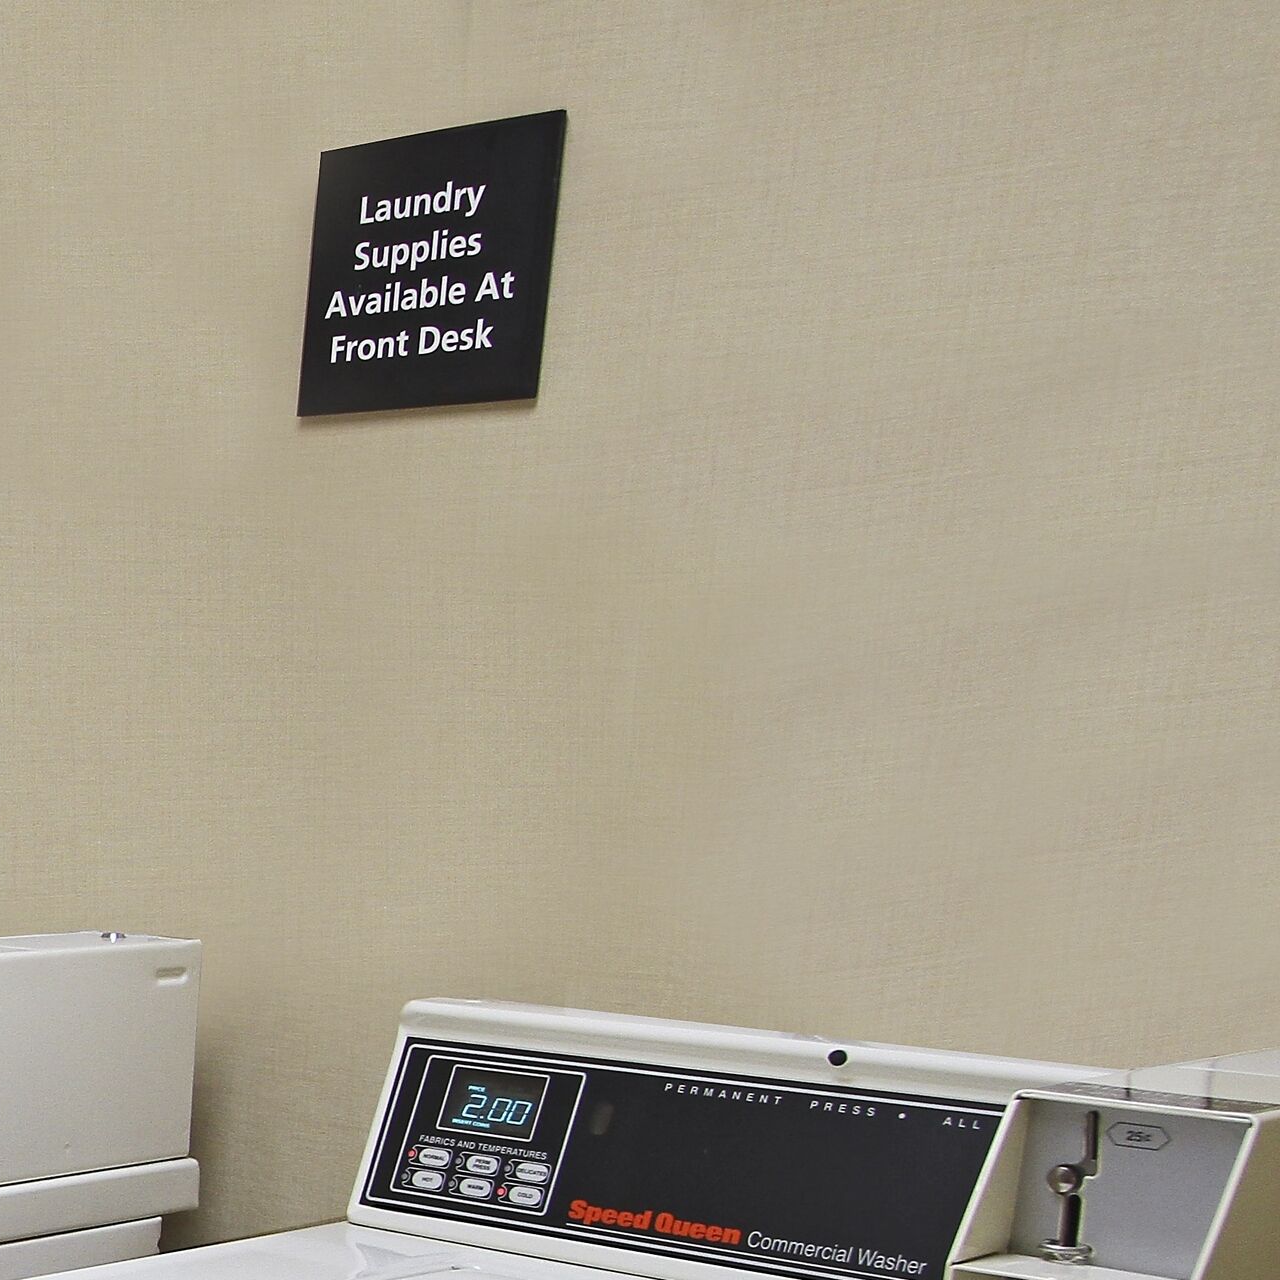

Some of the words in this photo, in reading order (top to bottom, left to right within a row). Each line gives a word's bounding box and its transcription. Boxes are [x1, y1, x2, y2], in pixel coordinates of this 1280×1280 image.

[360, 181, 486, 224] Laundry
[354, 230, 482, 273] Supplies
[325, 275, 466, 319] Available
[475, 271, 515, 302] At
[330, 330, 409, 363] Front
[417, 318, 494, 355] Desk
[462, 1094, 532, 1125] 2.00
[664, 1083, 782, 1105] PERMANENT
[809, 1101, 876, 1117] PRESS
[942, 1117, 980, 1130] ALL
[419, 1135, 456, 1147] FABRICS
[456, 1141, 476, 1150] AND
[477, 1143, 547, 1161] TEMPERATURES
[423, 1153, 446, 1161] NORMAL
[517, 1167, 547, 1177] DELICATES
[517, 1191, 534, 1200] COLD
[568, 1199, 652, 1230] Speed
[654, 1211, 742, 1246] Queen
[747, 1230, 854, 1263] Commercial
[858, 1249, 928, 1276] Washer
